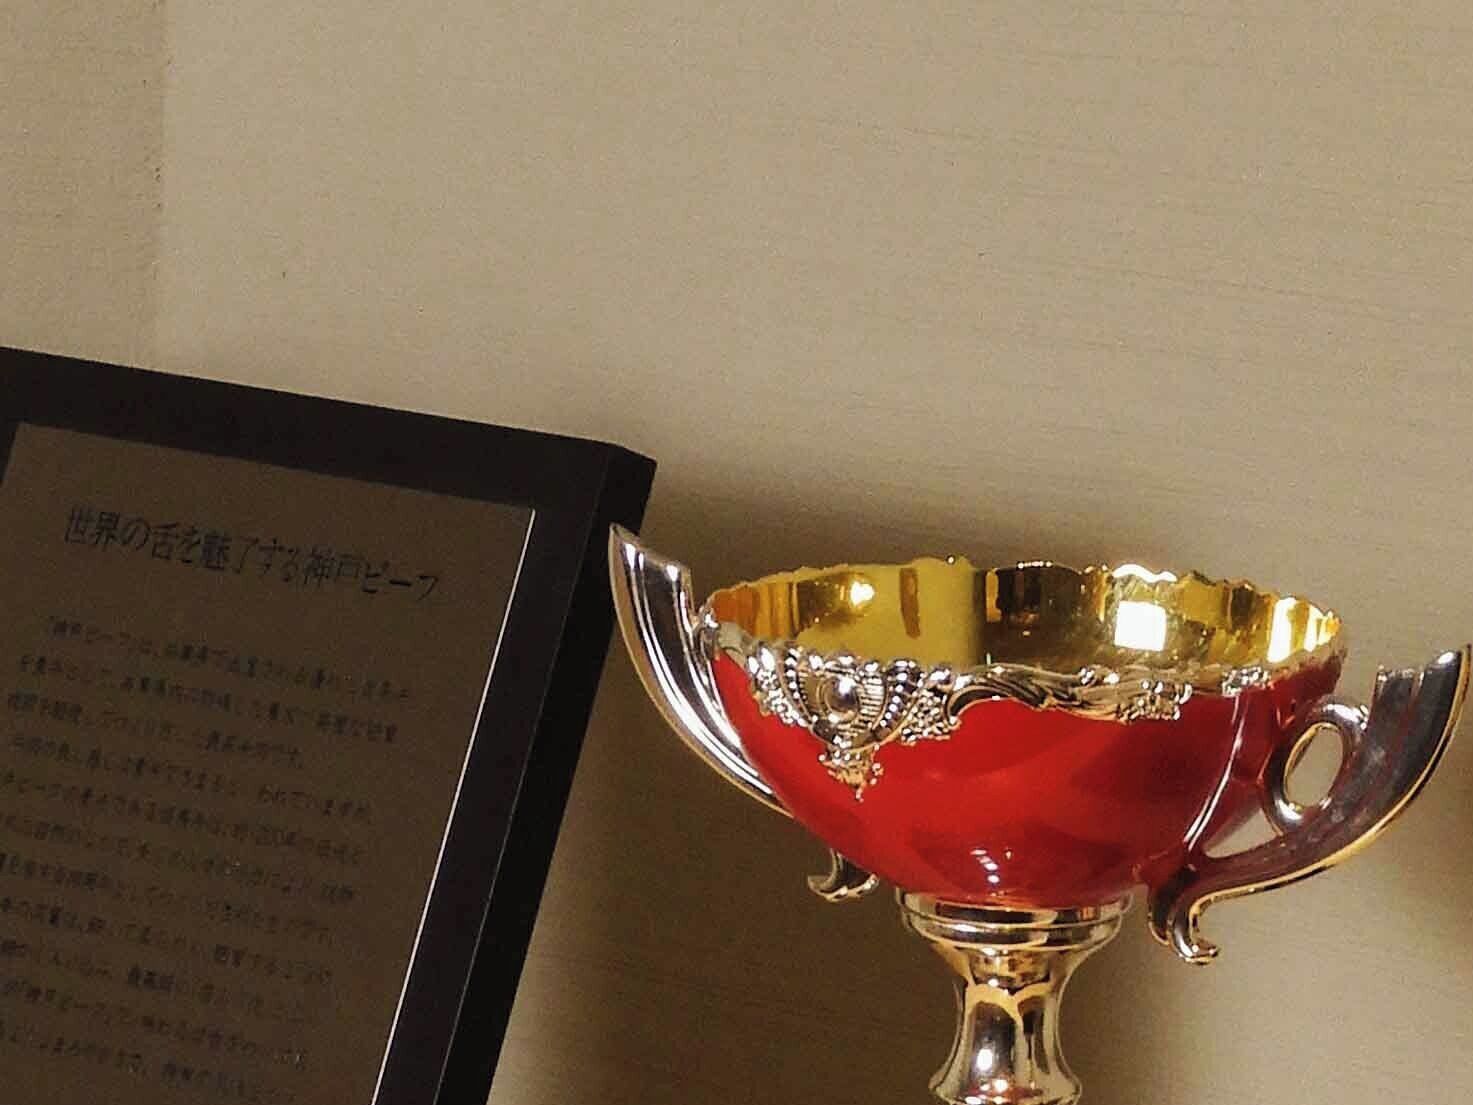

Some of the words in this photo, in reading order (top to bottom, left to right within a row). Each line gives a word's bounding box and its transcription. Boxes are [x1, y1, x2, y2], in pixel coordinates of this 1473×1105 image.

[64, 505, 440, 600] 世界の舌を魅了する神戸ビーフ
